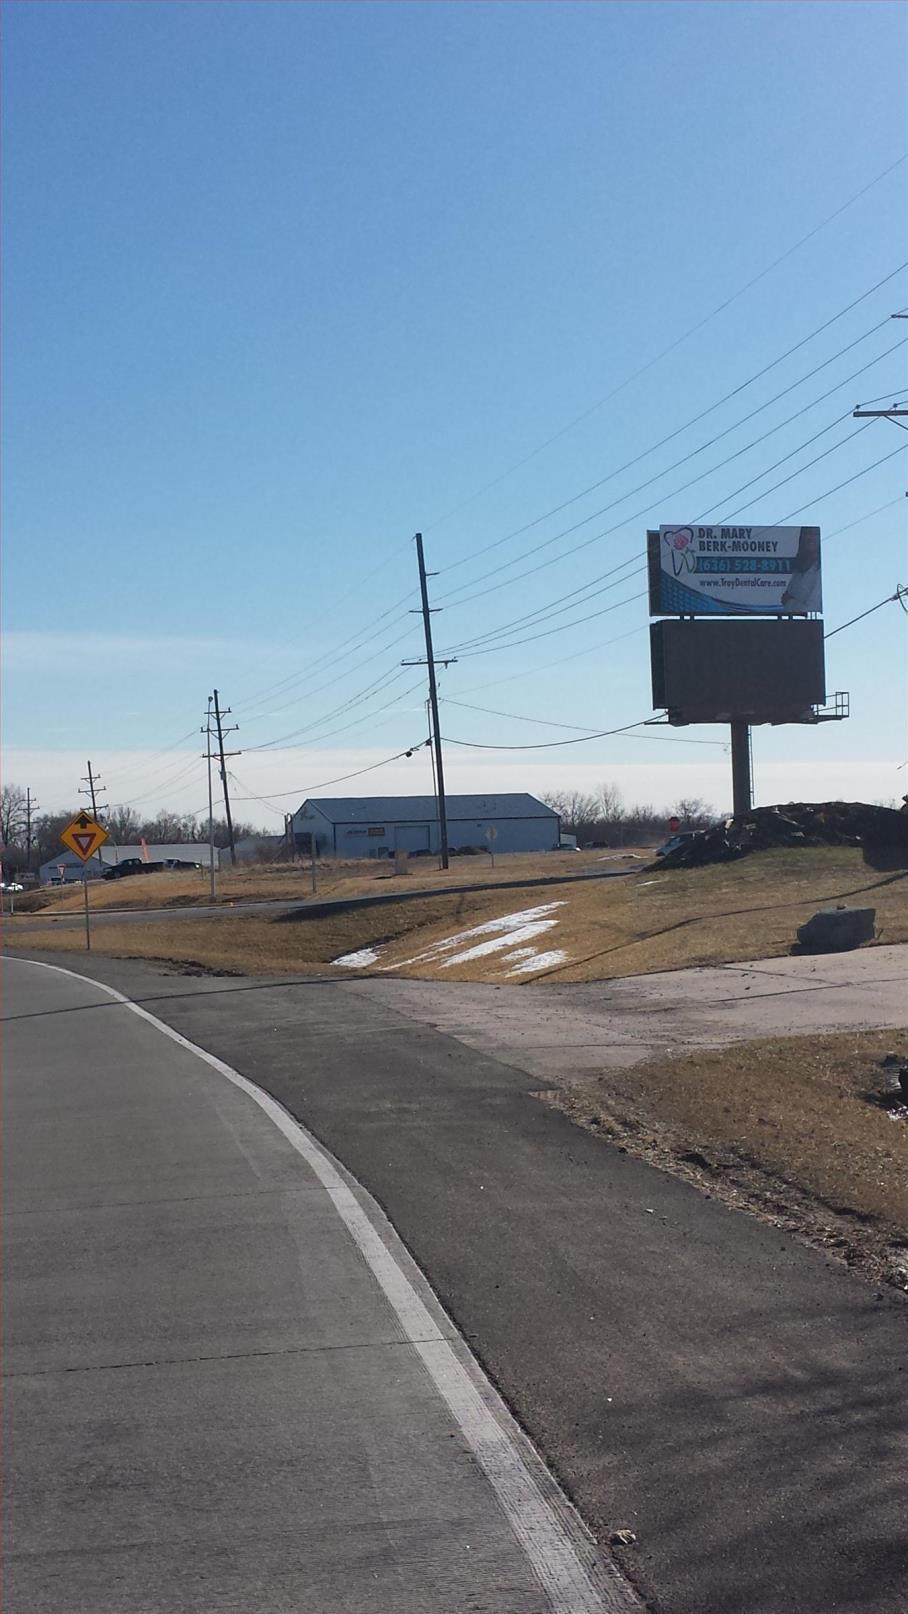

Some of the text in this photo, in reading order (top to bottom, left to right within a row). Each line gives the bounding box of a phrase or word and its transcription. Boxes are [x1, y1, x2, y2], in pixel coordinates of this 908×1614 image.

[698, 528, 753, 539] DR. MARY
[699, 541, 778, 552] BERK-MOONEY
[699, 559, 791, 571] (636) 528-8911
